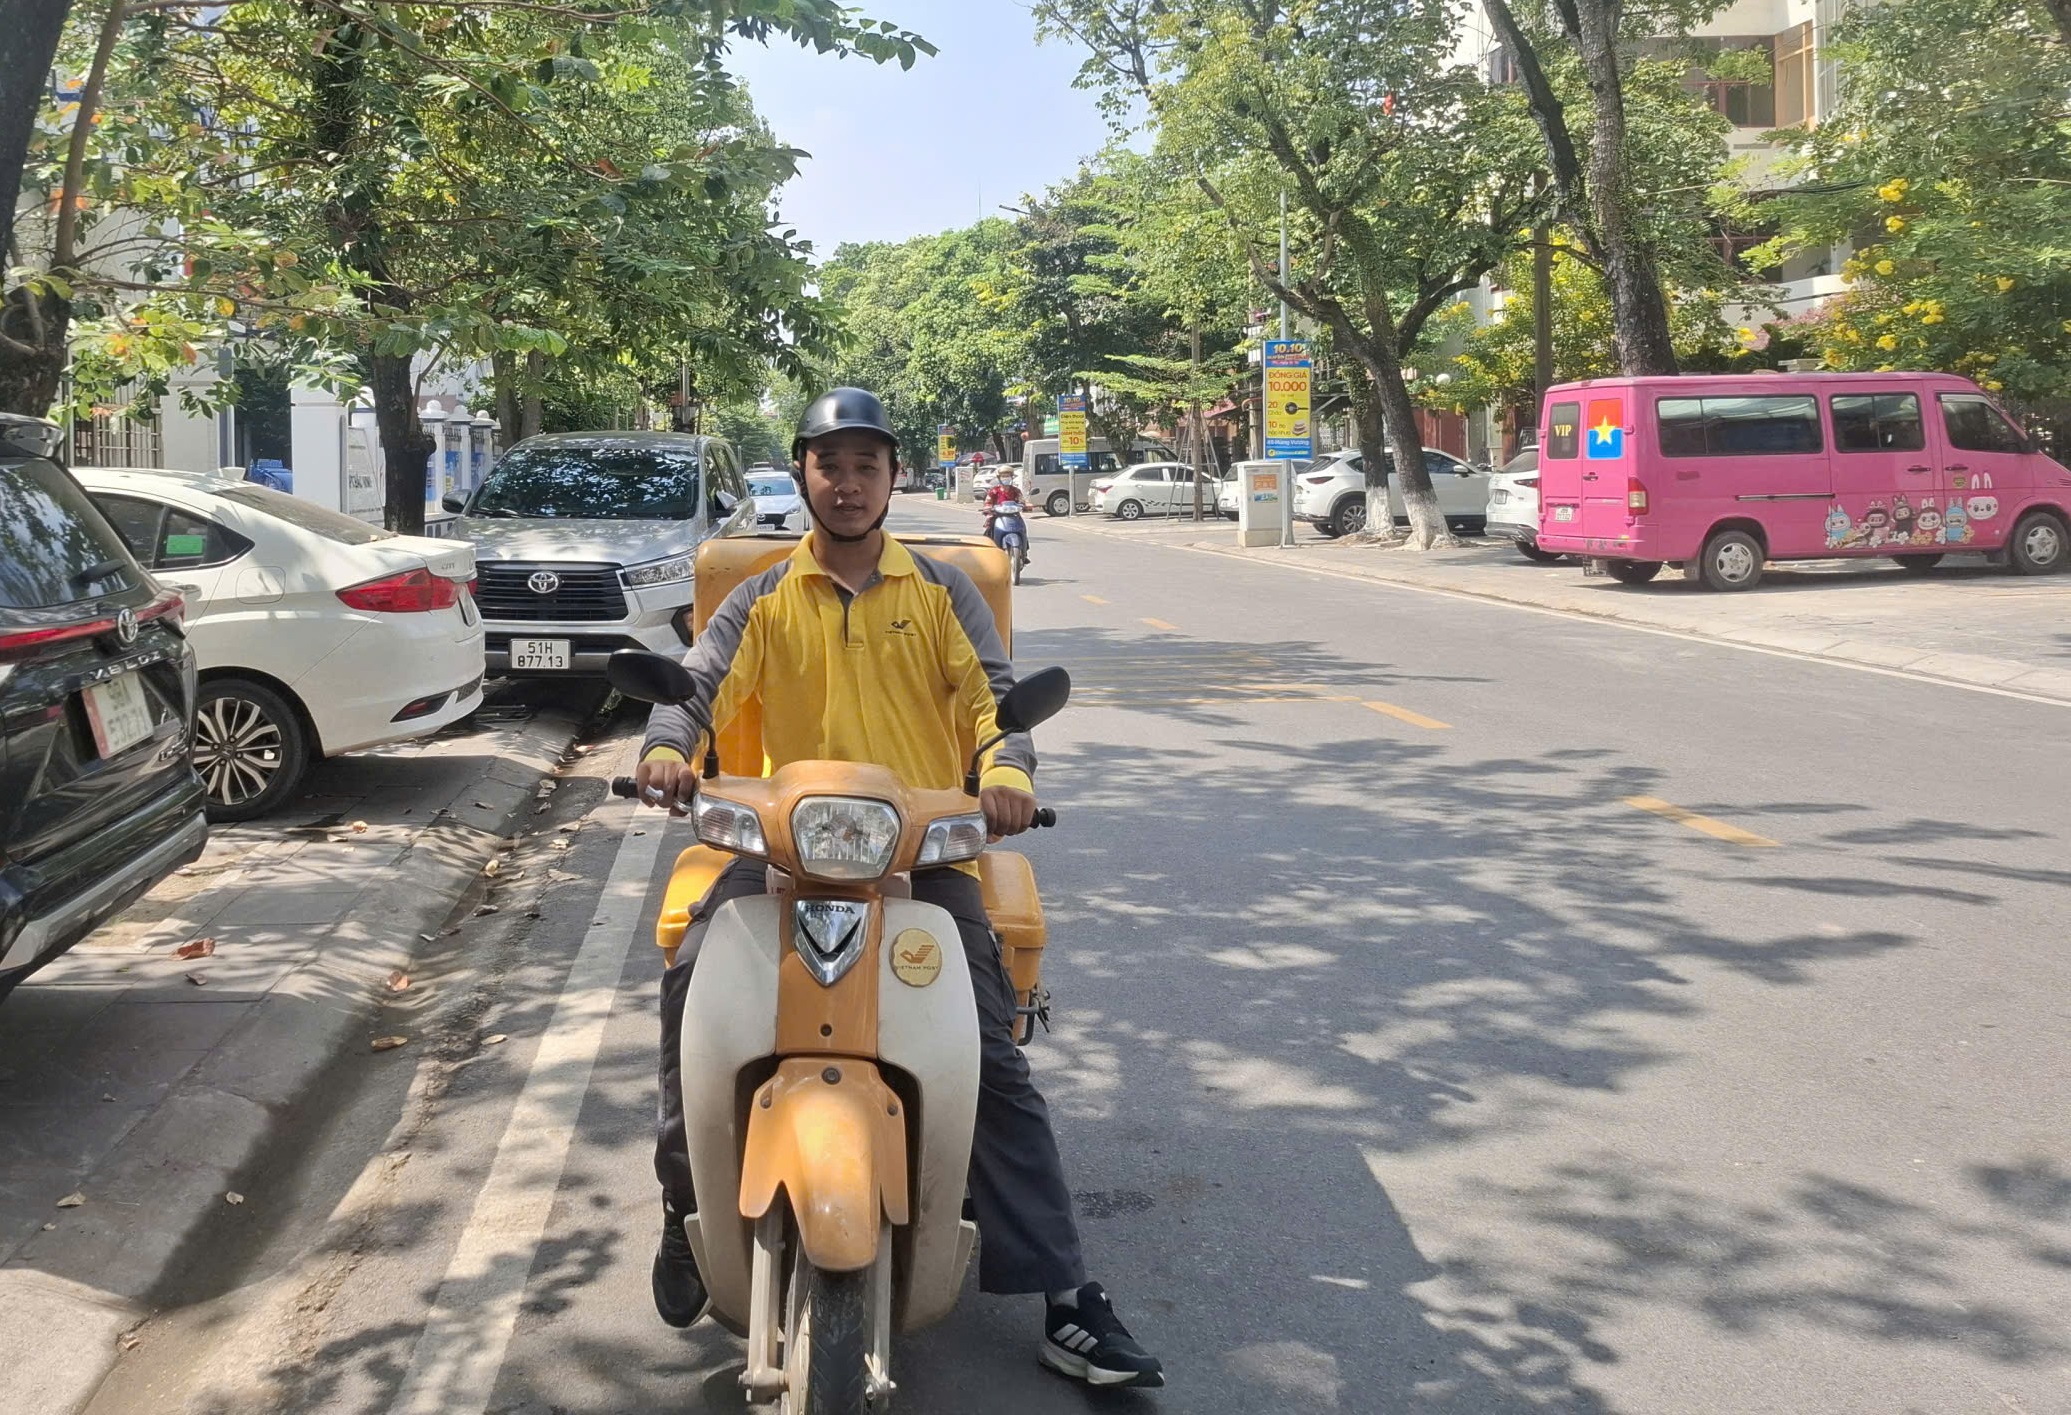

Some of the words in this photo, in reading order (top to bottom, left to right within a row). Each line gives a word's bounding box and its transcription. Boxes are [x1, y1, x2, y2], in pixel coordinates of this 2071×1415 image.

[1268, 381, 1307, 392] 10.000
[1267, 401, 1278, 409] 20
[1267, 421, 1278, 429] 10
[1554, 424, 1572, 437] VIP
[527, 641, 553, 654] 51H
[88, 650, 161, 680] VELOZ
[517, 655, 563, 668] 877.13
[806, 904, 855, 914] HONDA
